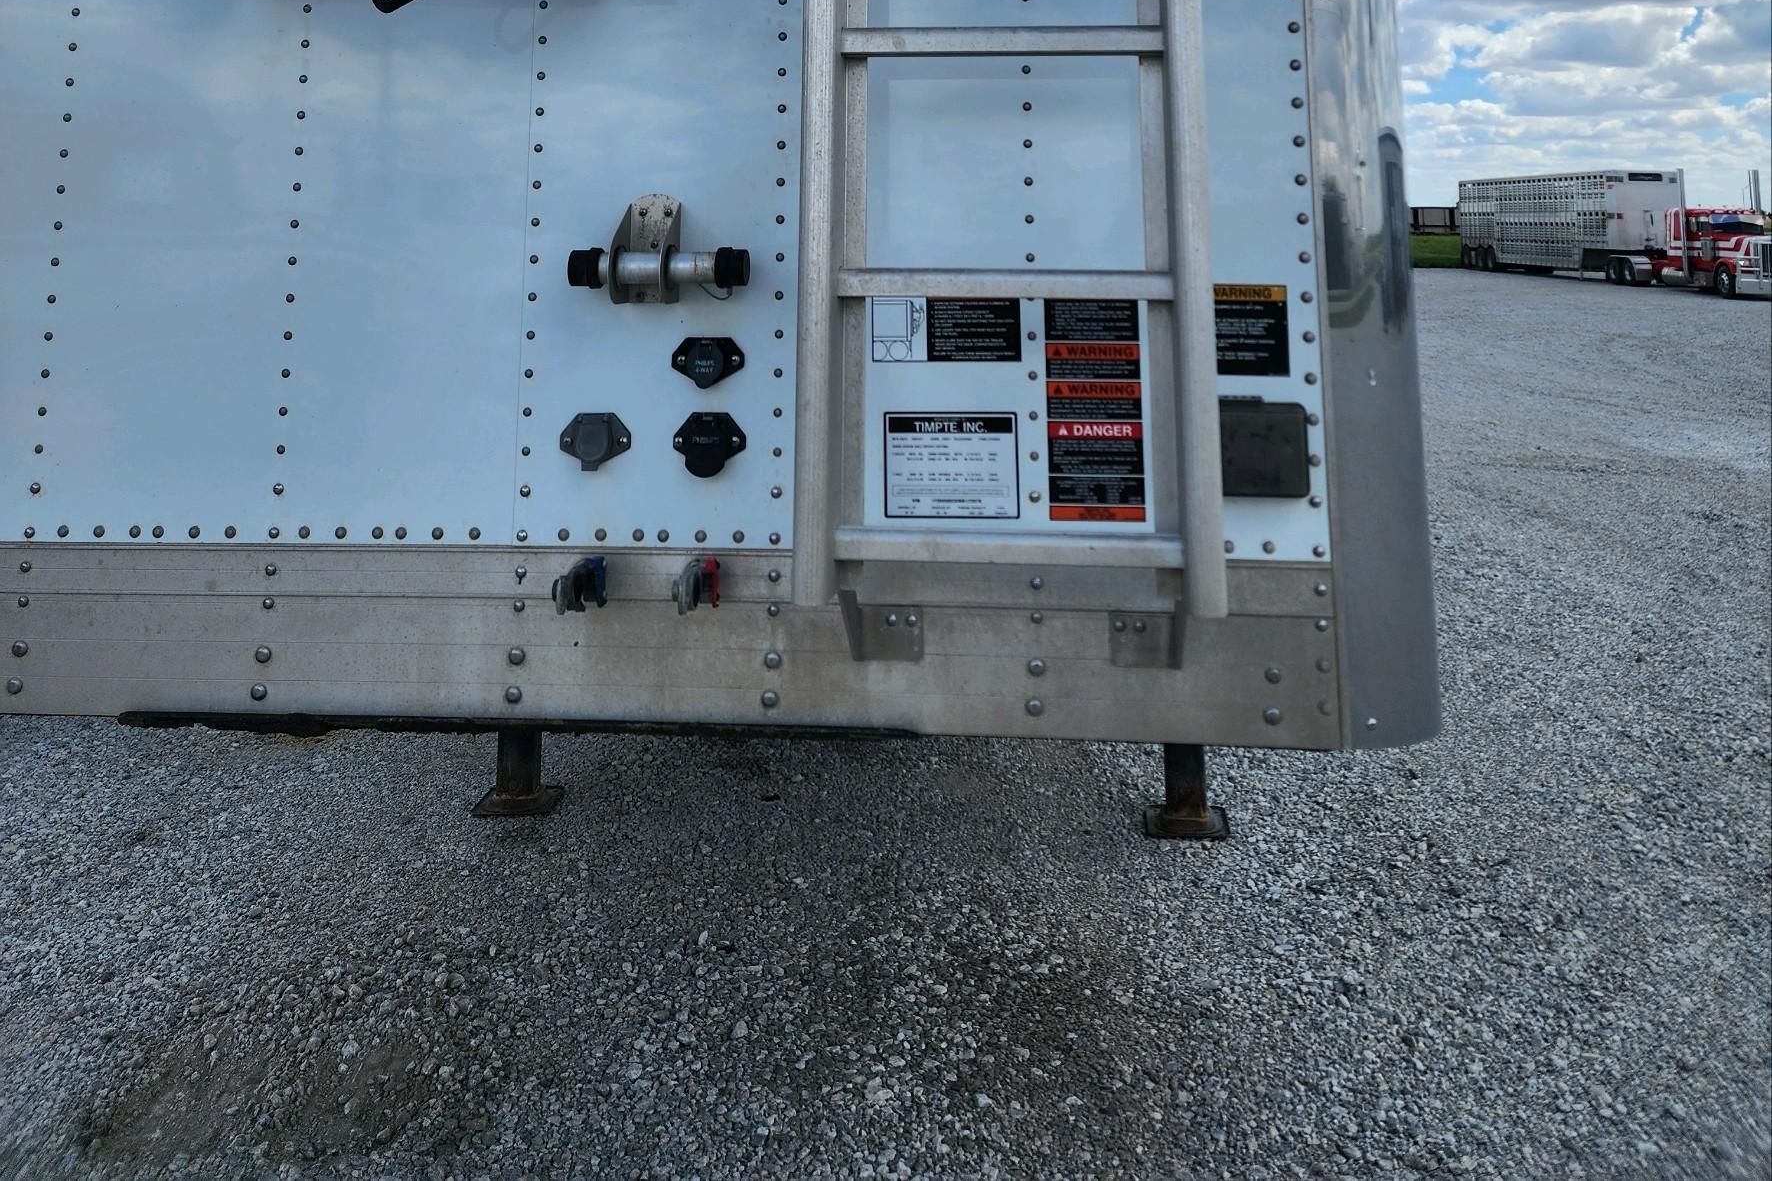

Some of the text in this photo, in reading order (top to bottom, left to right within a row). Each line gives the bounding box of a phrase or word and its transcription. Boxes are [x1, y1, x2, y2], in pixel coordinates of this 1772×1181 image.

[1066, 346, 1133, 358] WARNING
[1068, 384, 1135, 396] WARNING
[914, 421, 987, 434] TIMPTE INC.
[1073, 425, 1132, 437] DANGER
